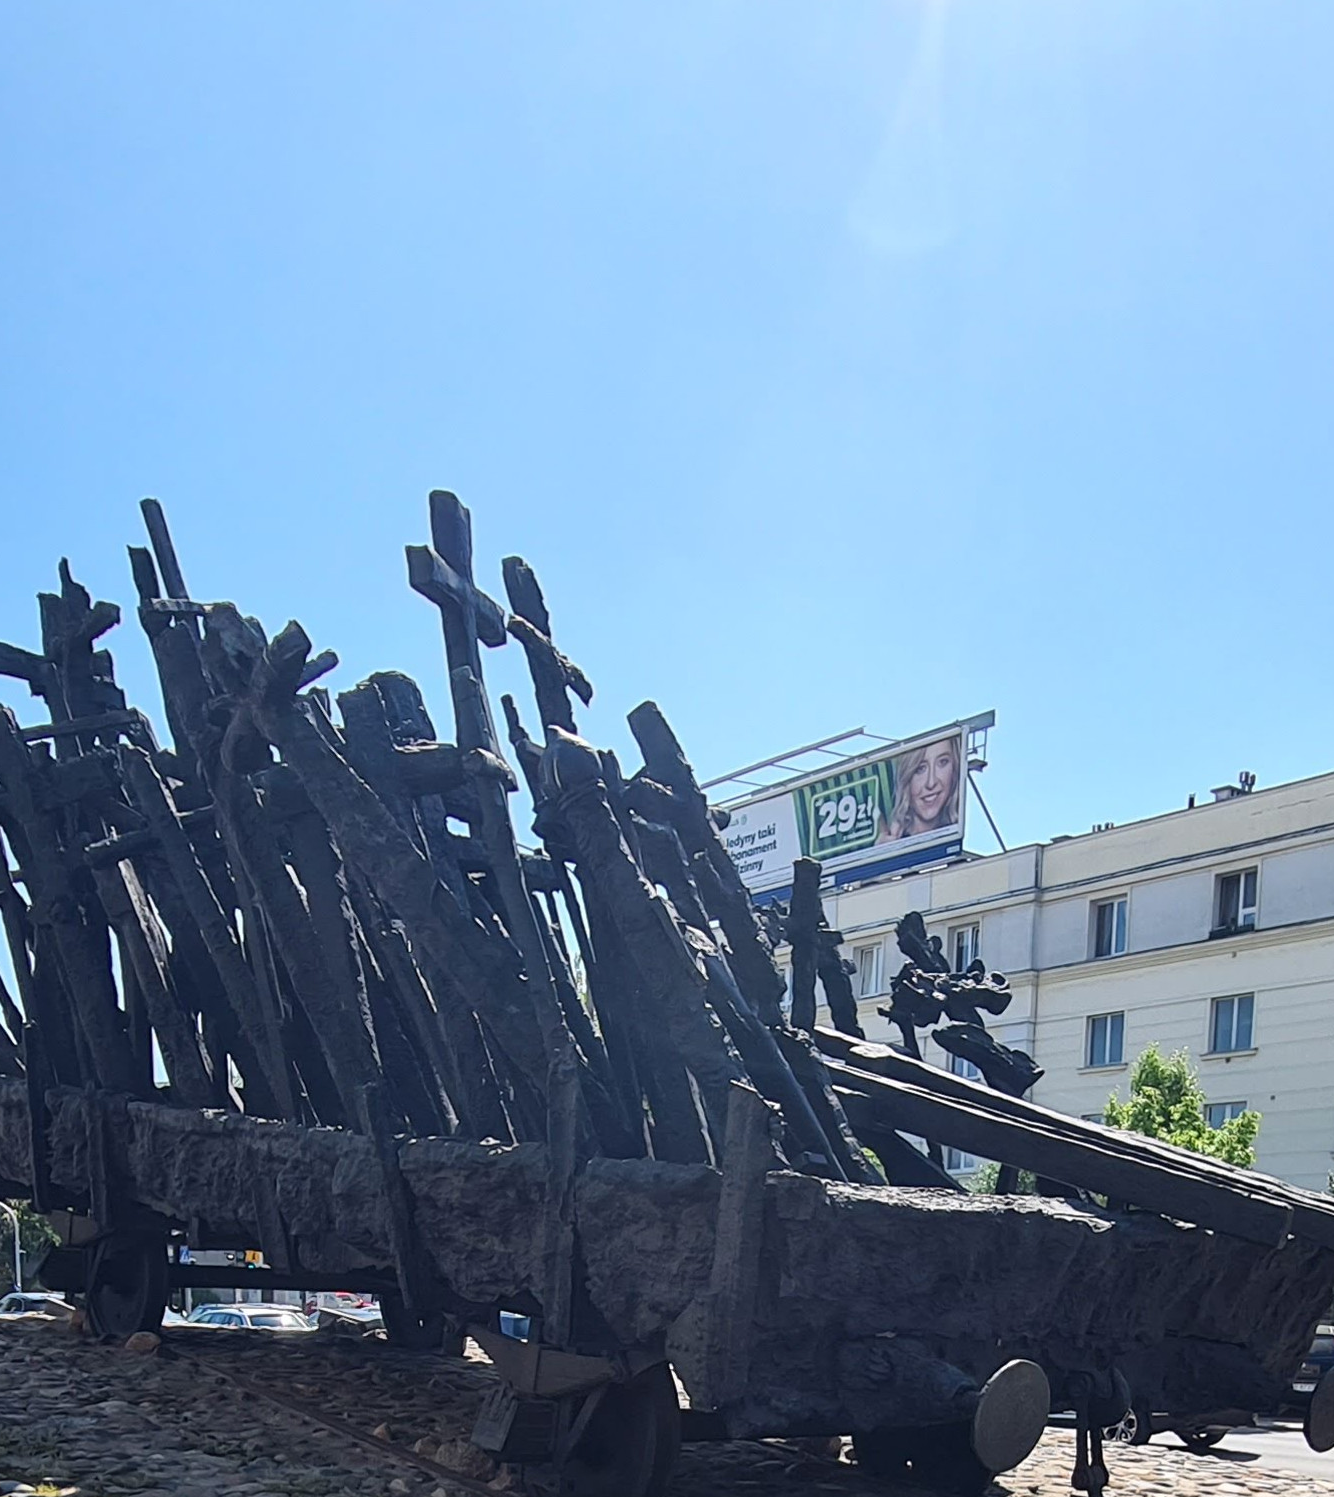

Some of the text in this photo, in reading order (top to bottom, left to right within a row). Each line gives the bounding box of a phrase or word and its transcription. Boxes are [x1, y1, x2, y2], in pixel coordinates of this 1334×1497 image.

[757, 822, 777, 840] taki
[730, 840, 778, 861] bonament
[737, 860, 764, 874] zinny
